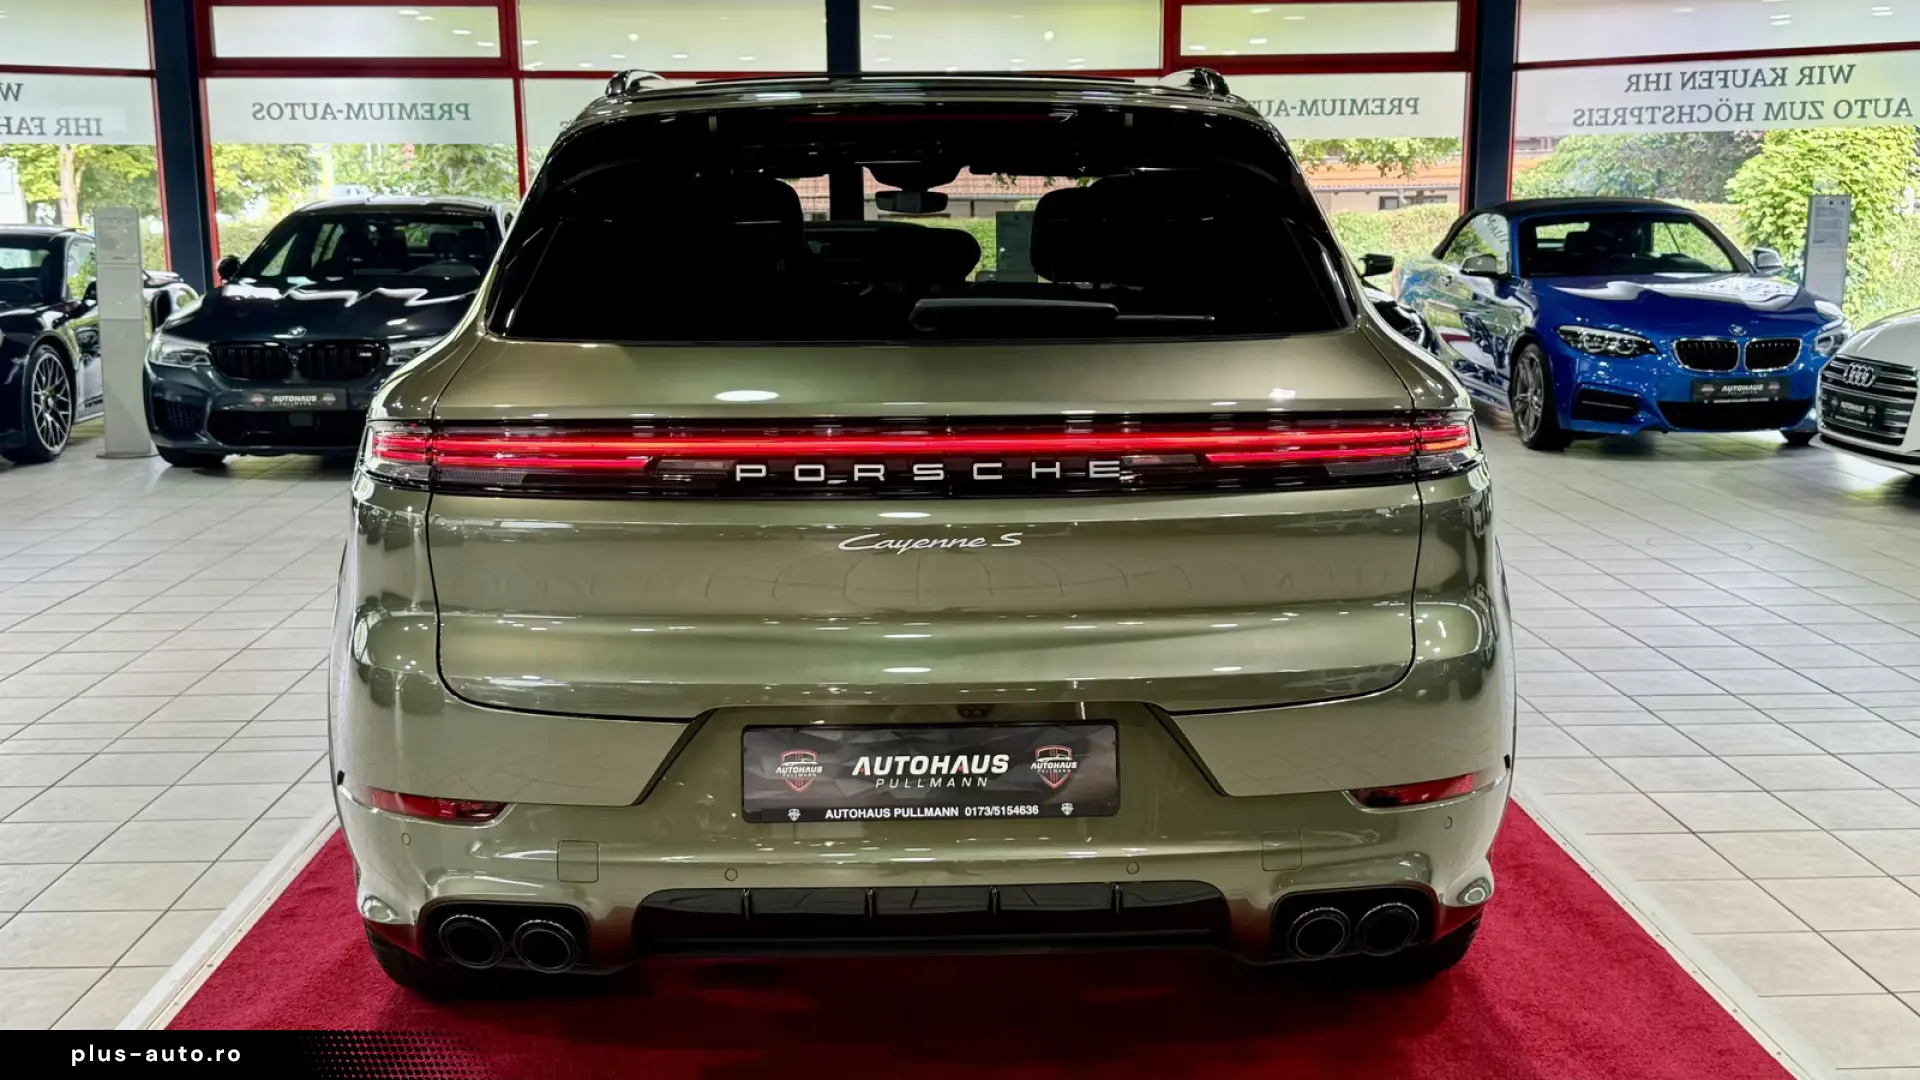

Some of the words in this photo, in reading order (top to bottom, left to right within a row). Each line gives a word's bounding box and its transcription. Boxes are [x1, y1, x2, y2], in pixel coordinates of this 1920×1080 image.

[735, 460, 1120, 482] PORSCHE
[838, 533, 987, 555] Cayenne
[991, 532, 1023, 547] S
[775, 766, 823, 774] AUTOHAUS
[852, 754, 1010, 776] AUTOHAUS
[1030, 761, 1078, 770] AUTOHAUS
[875, 776, 988, 789] PULLMANN
[825, 808, 891, 819] AUTOHAUS
[893, 807, 959, 818] PULLMANN
[964, 805, 1039, 817] 0173/5154636
